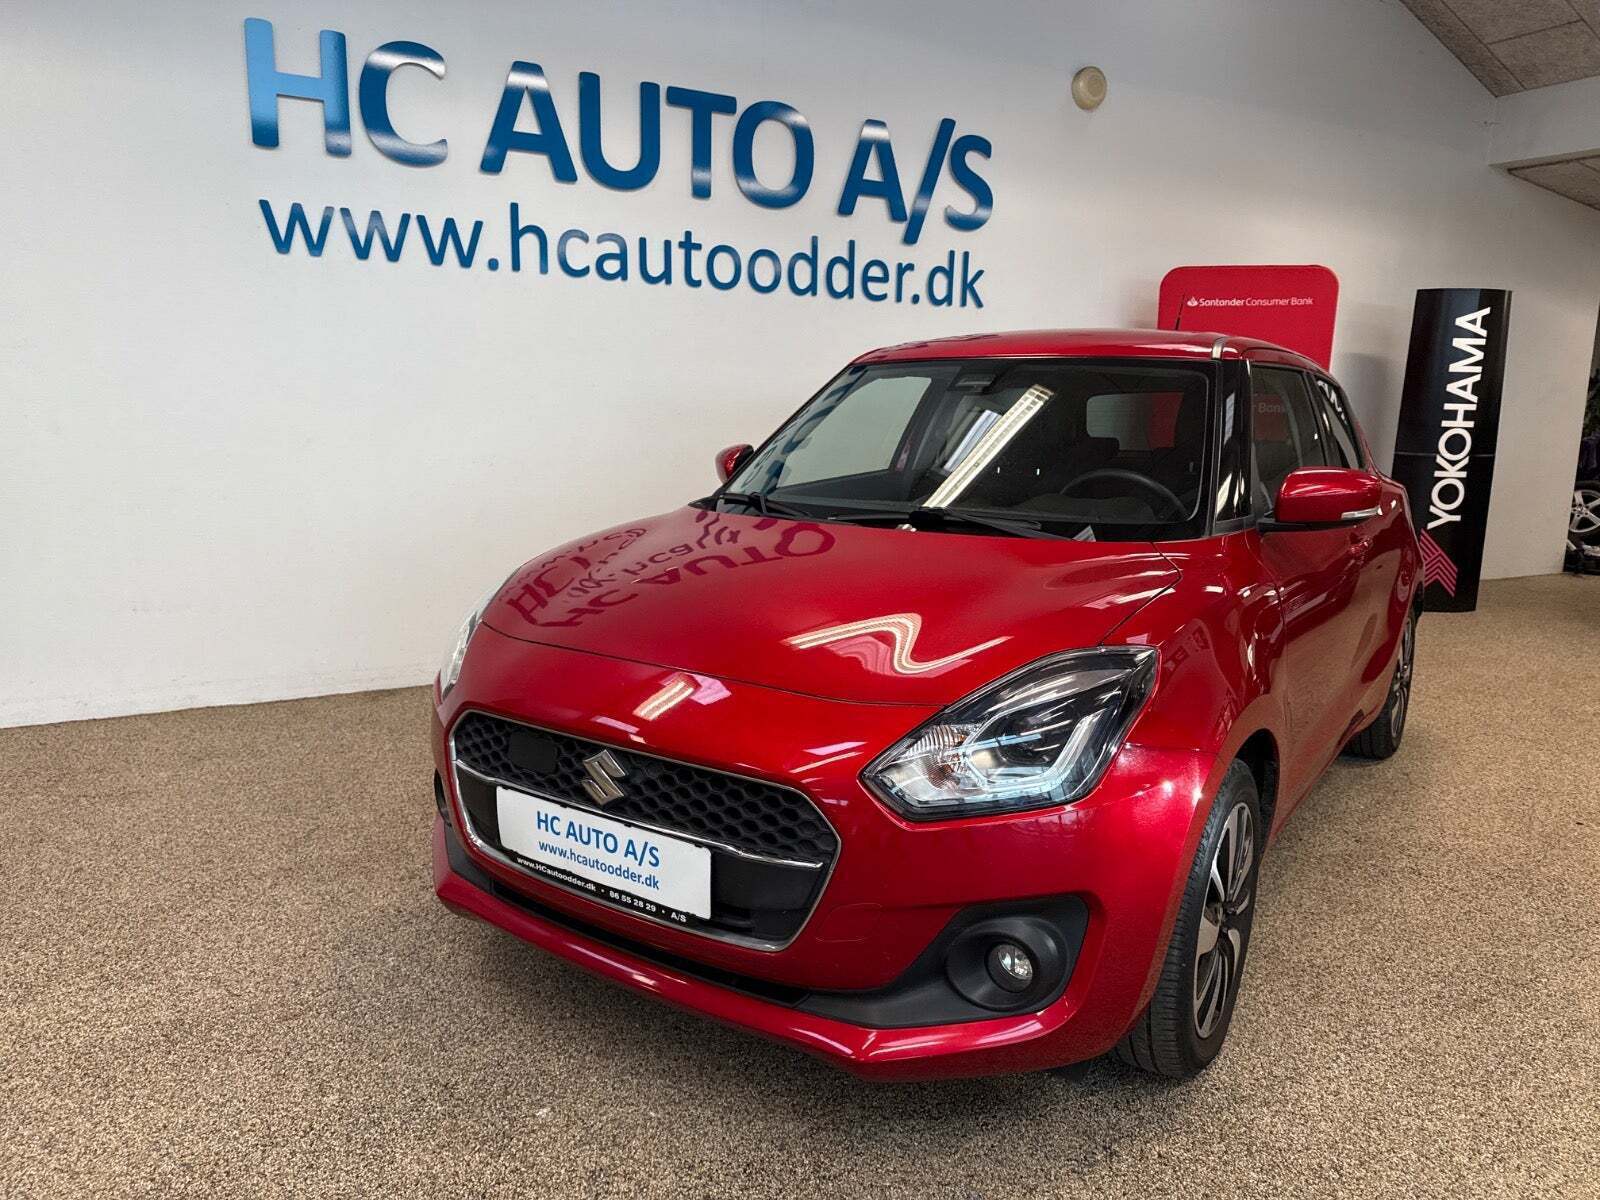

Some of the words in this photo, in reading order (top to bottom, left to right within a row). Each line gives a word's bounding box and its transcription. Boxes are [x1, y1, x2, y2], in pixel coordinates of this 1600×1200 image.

[244, 18, 448, 168] HC
[480, 61, 815, 209] AUTO
[837, 118, 993, 245] A/S
[258, 198, 985, 309] www.hcautoodder.dk
[1199, 297, 1245, 307] Santander
[1245, 297, 1290, 306] Consumer
[1290, 296, 1313, 306] Bank
[1427, 306, 1491, 530] YOKOHAMA
[536, 810, 561, 836] HC
[565, 821, 619, 854] AUTO
[623, 839, 661, 868] A/S
[538, 840, 660, 891] www.hcautoodder.dk
[516, 856, 597, 893] www.HCautoodder.dk
[670, 911, 688, 923] A/S
